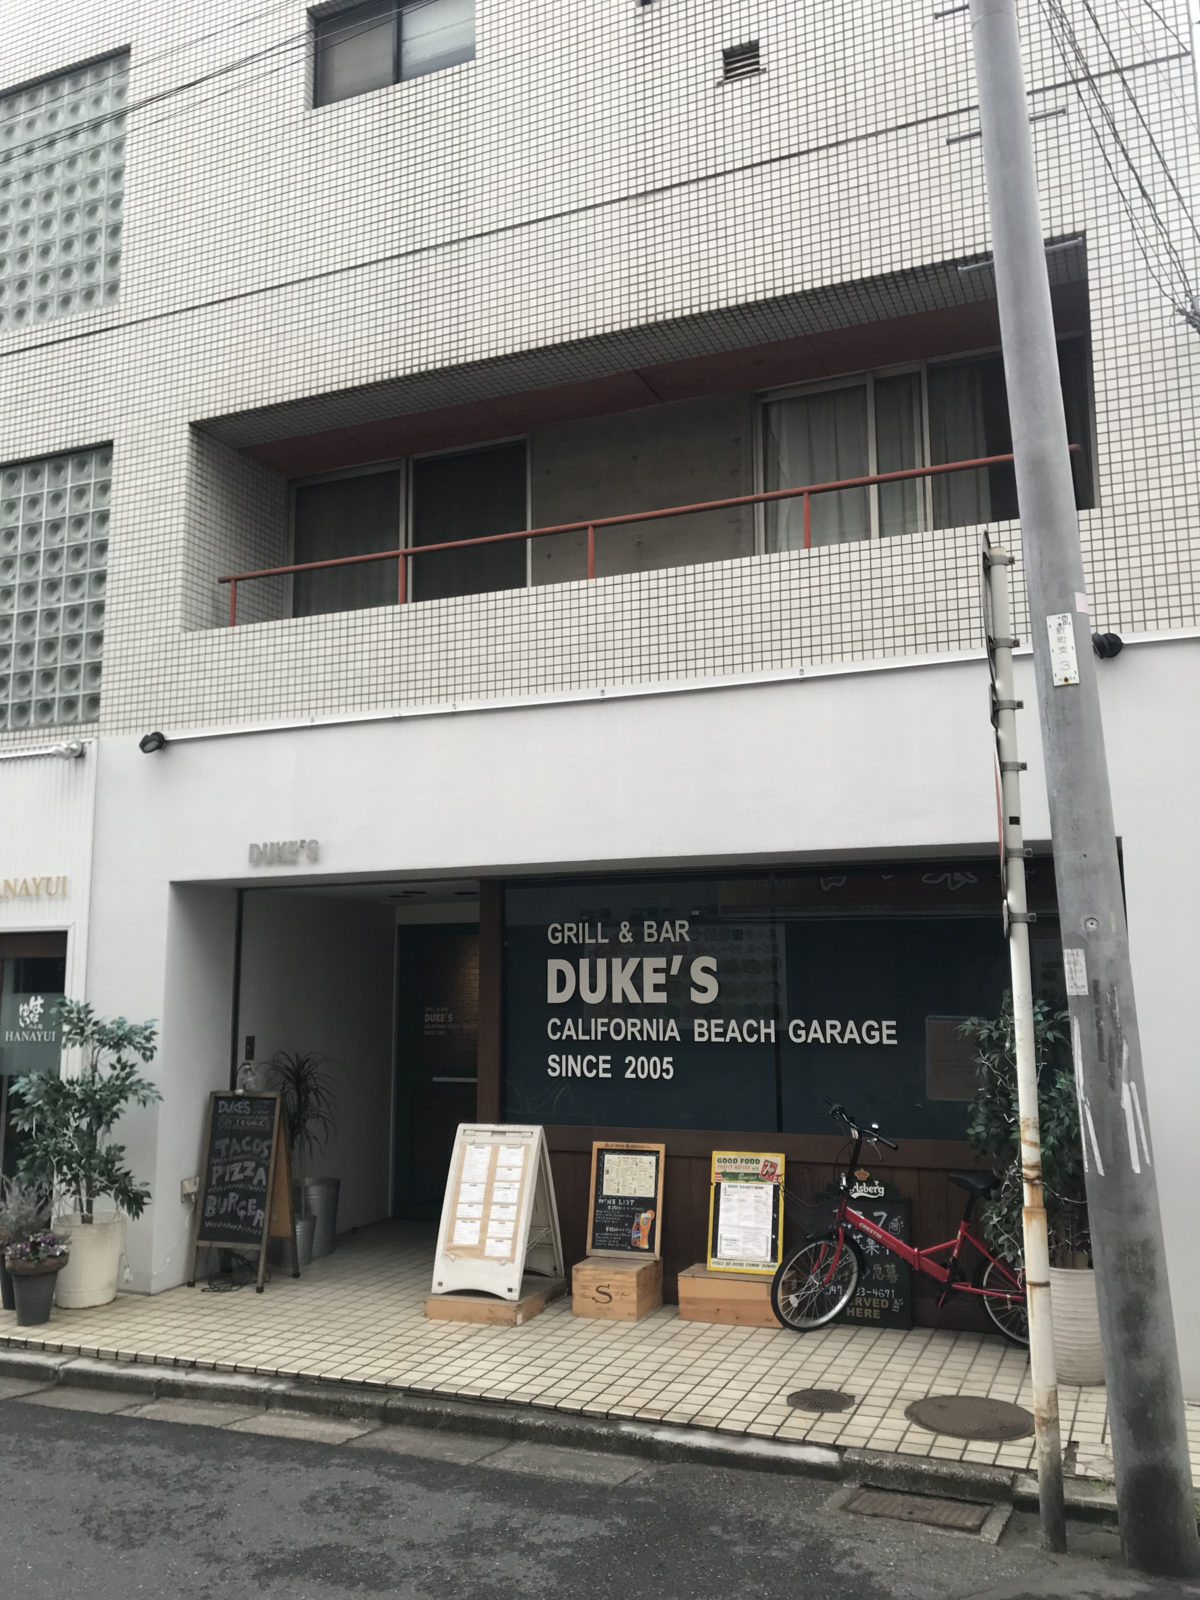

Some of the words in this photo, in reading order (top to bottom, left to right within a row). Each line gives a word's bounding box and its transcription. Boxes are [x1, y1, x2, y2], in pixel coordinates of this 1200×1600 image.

[248, 839, 320, 866] DUKE'S
[0, 876, 68, 897] NAYUI
[547, 922, 608, 945] GRILL
[619, 921, 634, 944] &
[643, 919, 690, 943] BAR
[547, 955, 719, 1004] DUKE'S
[5, 1031, 56, 1042] HANAYUI
[547, 1017, 681, 1042] CALIFORNIA
[694, 1019, 776, 1043] BEACH
[788, 1020, 898, 1045] GARAGE
[547, 1054, 612, 1079] SINCE
[624, 1056, 674, 1080] 2005
[214, 1136, 273, 1158] TACOS
[211, 1161, 267, 1186] PIZZA
[591, 1284, 613, 1304] S
[846, 1307, 881, 1320] HERE
